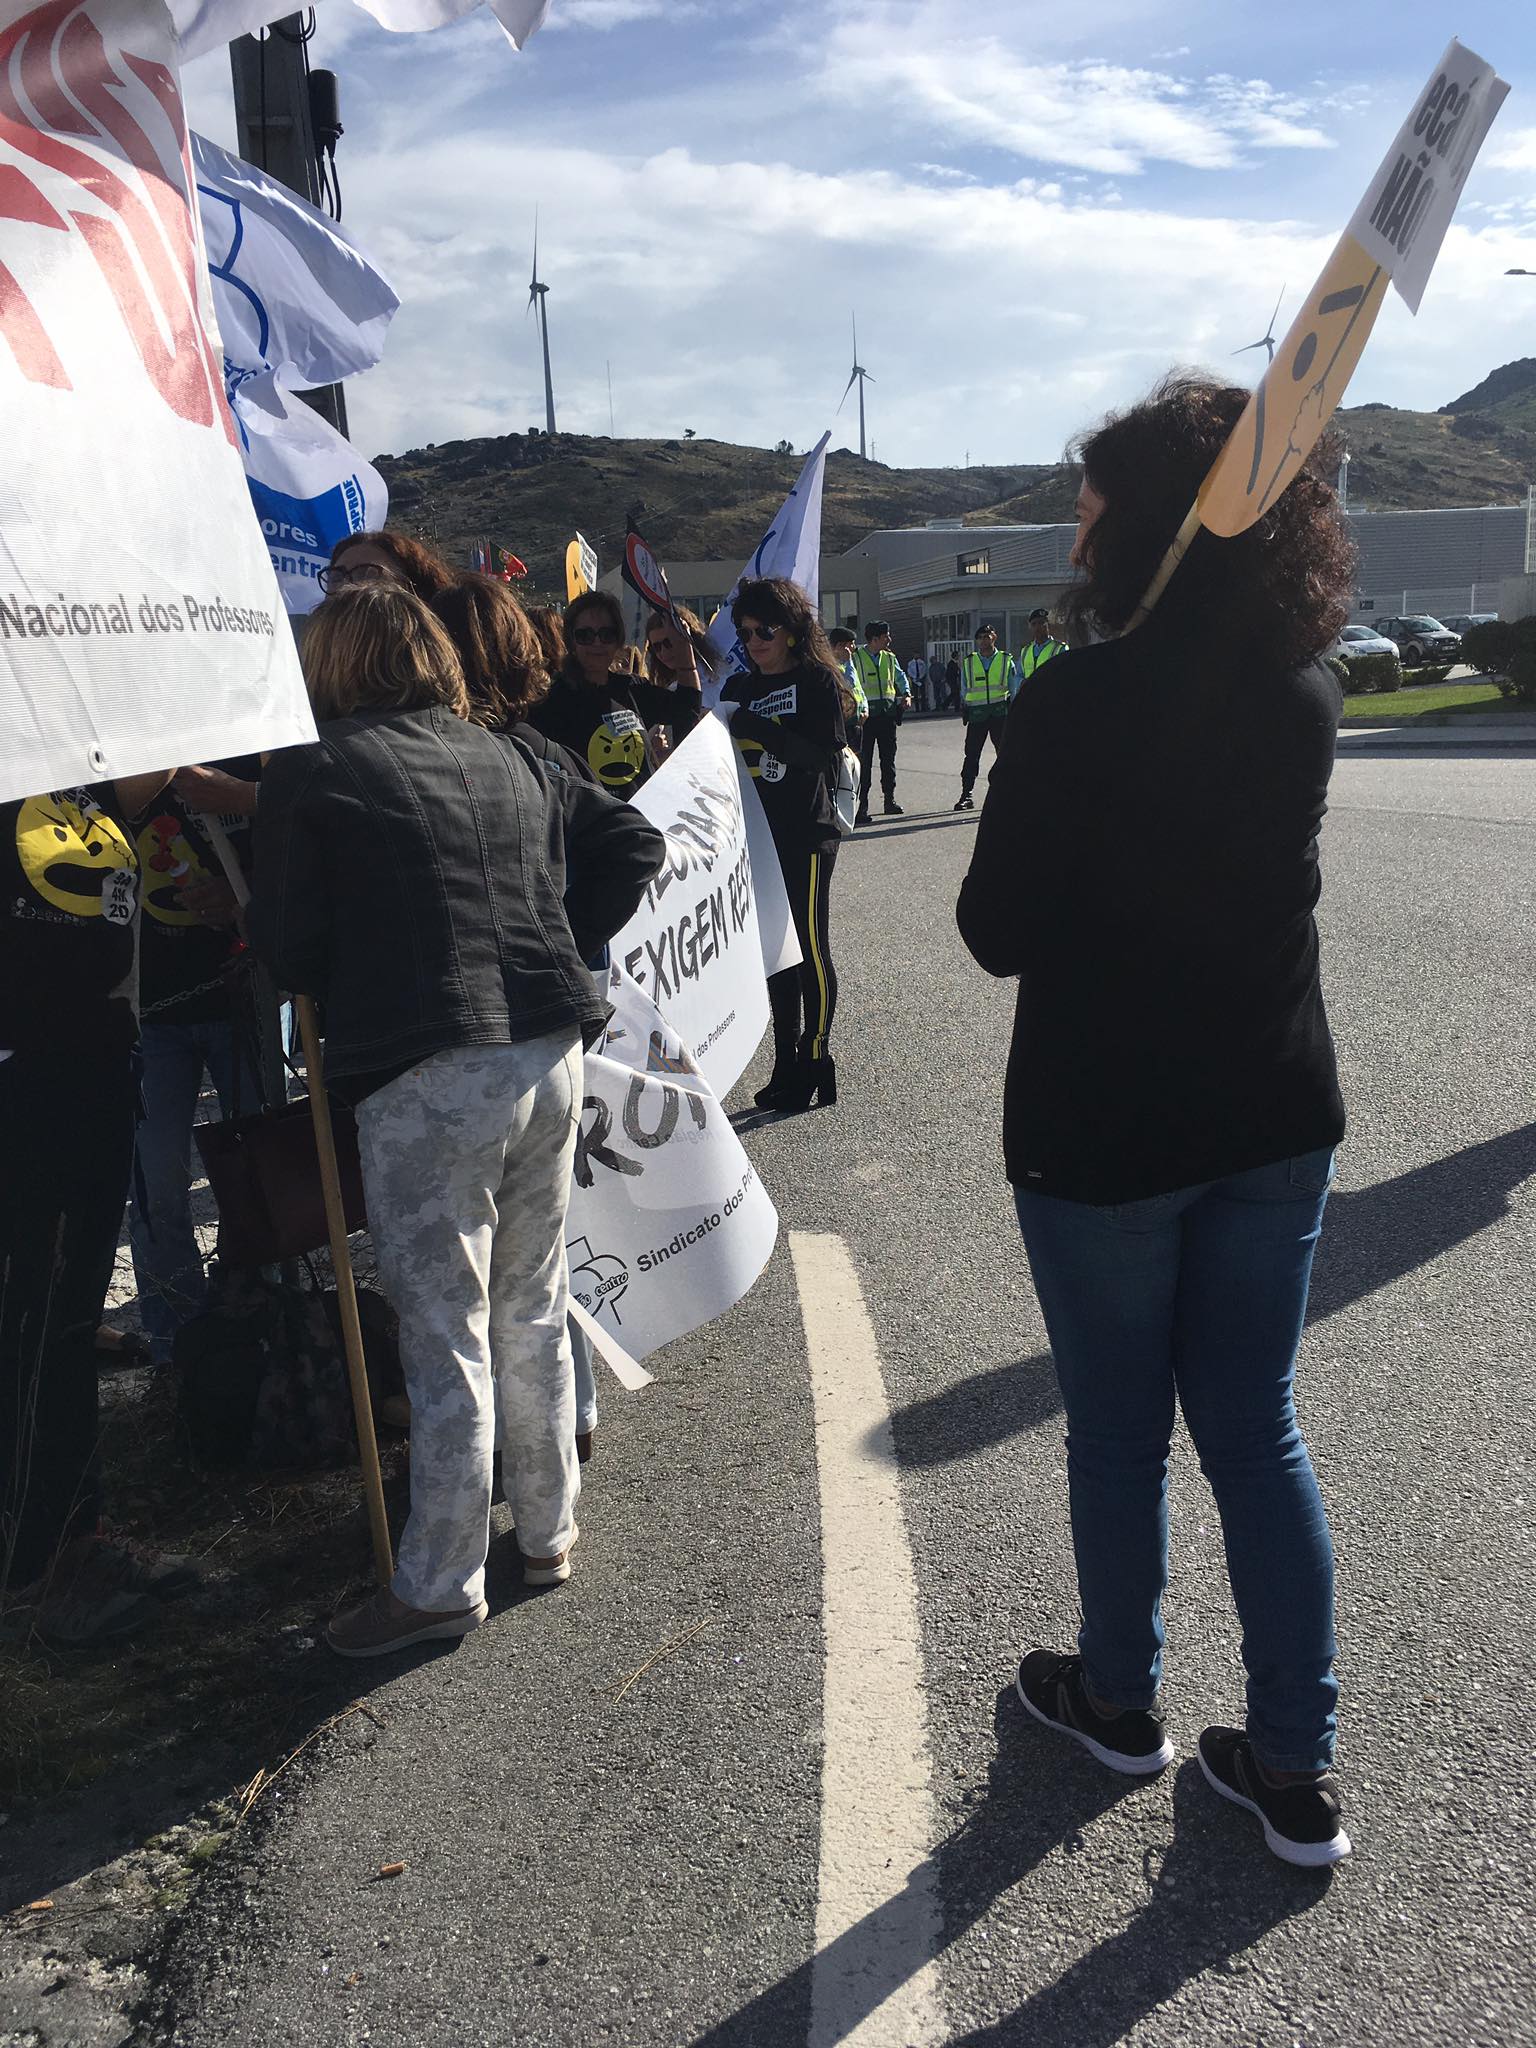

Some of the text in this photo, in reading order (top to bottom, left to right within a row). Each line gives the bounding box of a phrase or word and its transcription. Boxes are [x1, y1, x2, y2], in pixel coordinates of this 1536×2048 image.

[261, 518, 318, 548] ores
[270, 553, 322, 579] entr
[0, 593, 274, 639] Nacional dos Professores
[765, 770, 779, 779] 2D
[766, 761, 779, 771] 4M
[109, 903, 129, 919] 2D
[625, 886, 729, 1003] EXIGEM
[697, 1009, 736, 1058] dos Professores
[636, 1213, 721, 1273] Sindicato
[723, 1188, 744, 1217] dos
[595, 1271, 629, 1297] centro
